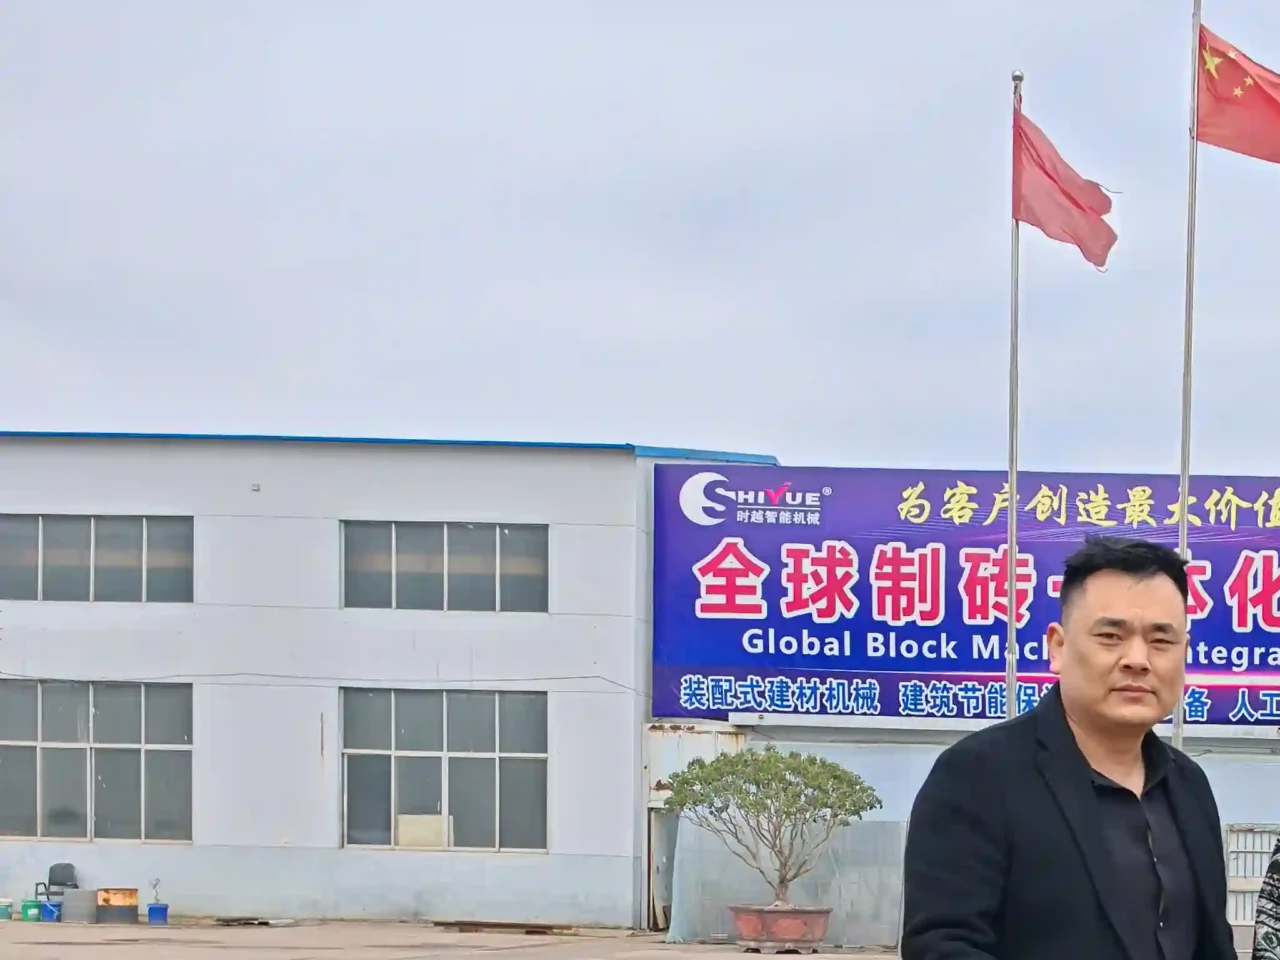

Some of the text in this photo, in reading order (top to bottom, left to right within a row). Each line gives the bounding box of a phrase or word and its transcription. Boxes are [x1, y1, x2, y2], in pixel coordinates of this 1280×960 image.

[736, 510, 820, 525] 时越智能机械
[742, 628, 852, 658] Global
[867, 630, 958, 660] Block
[680, 675, 880, 714] 装配式建材机械
